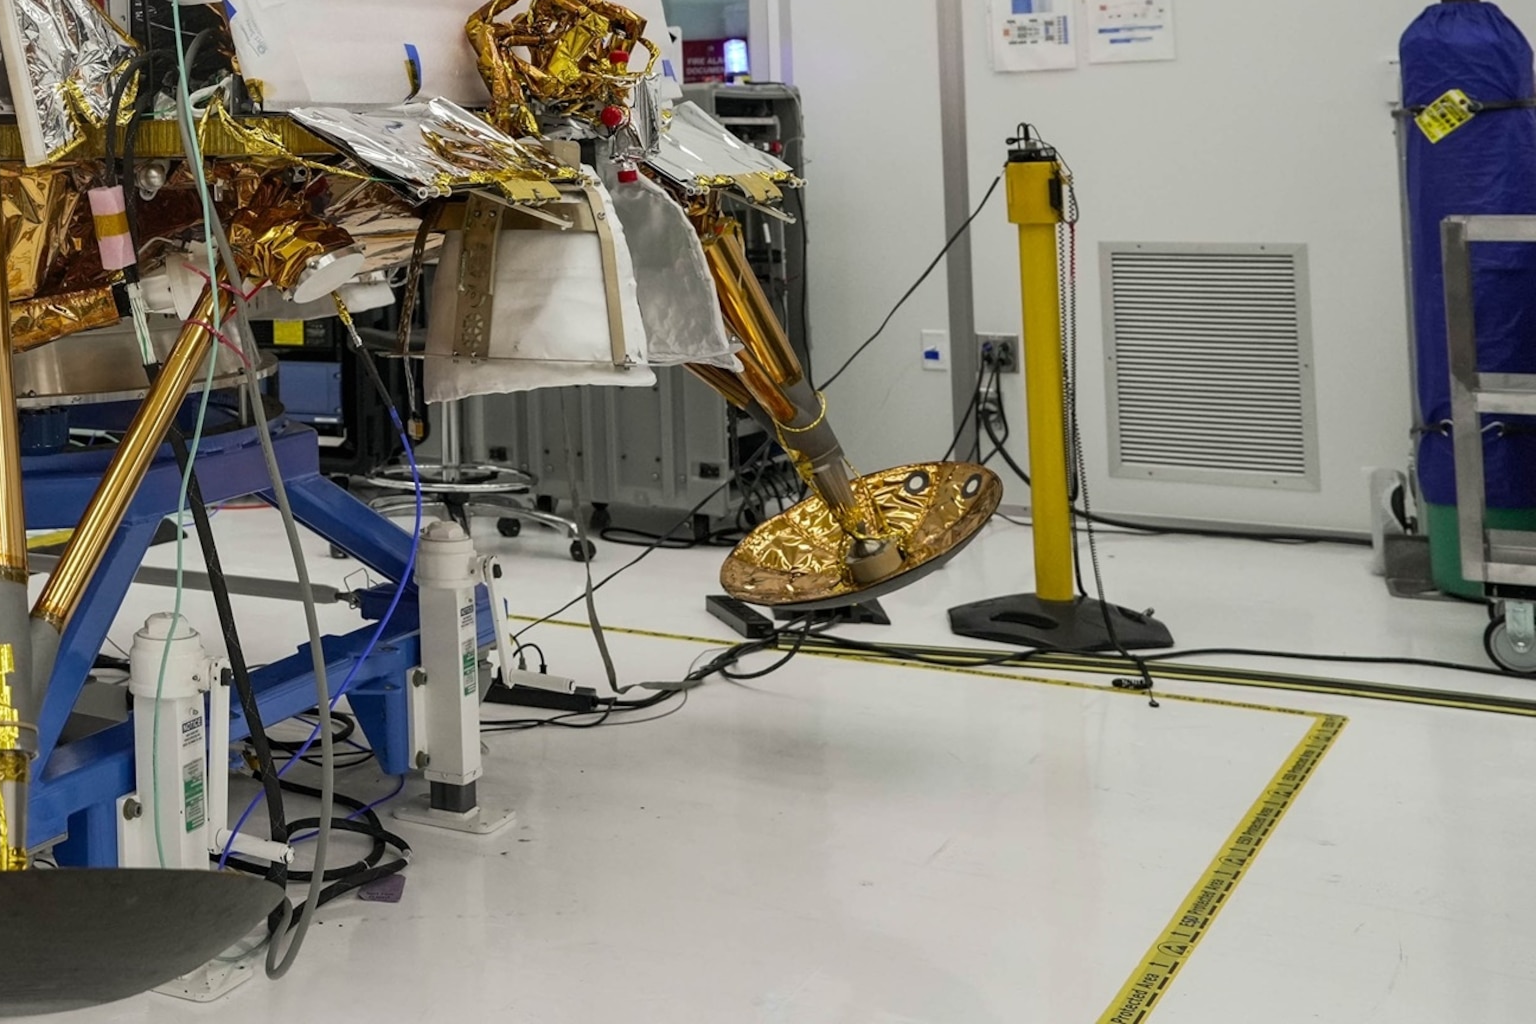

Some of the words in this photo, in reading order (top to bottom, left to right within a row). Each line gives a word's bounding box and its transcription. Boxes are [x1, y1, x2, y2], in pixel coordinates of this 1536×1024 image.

[1204, 878, 1225, 891] Area
[1186, 888, 1217, 916] Protected
[1178, 914, 1200, 928] ESD
[1109, 987, 1150, 1024] Protected
[1135, 972, 1161, 990] Area
